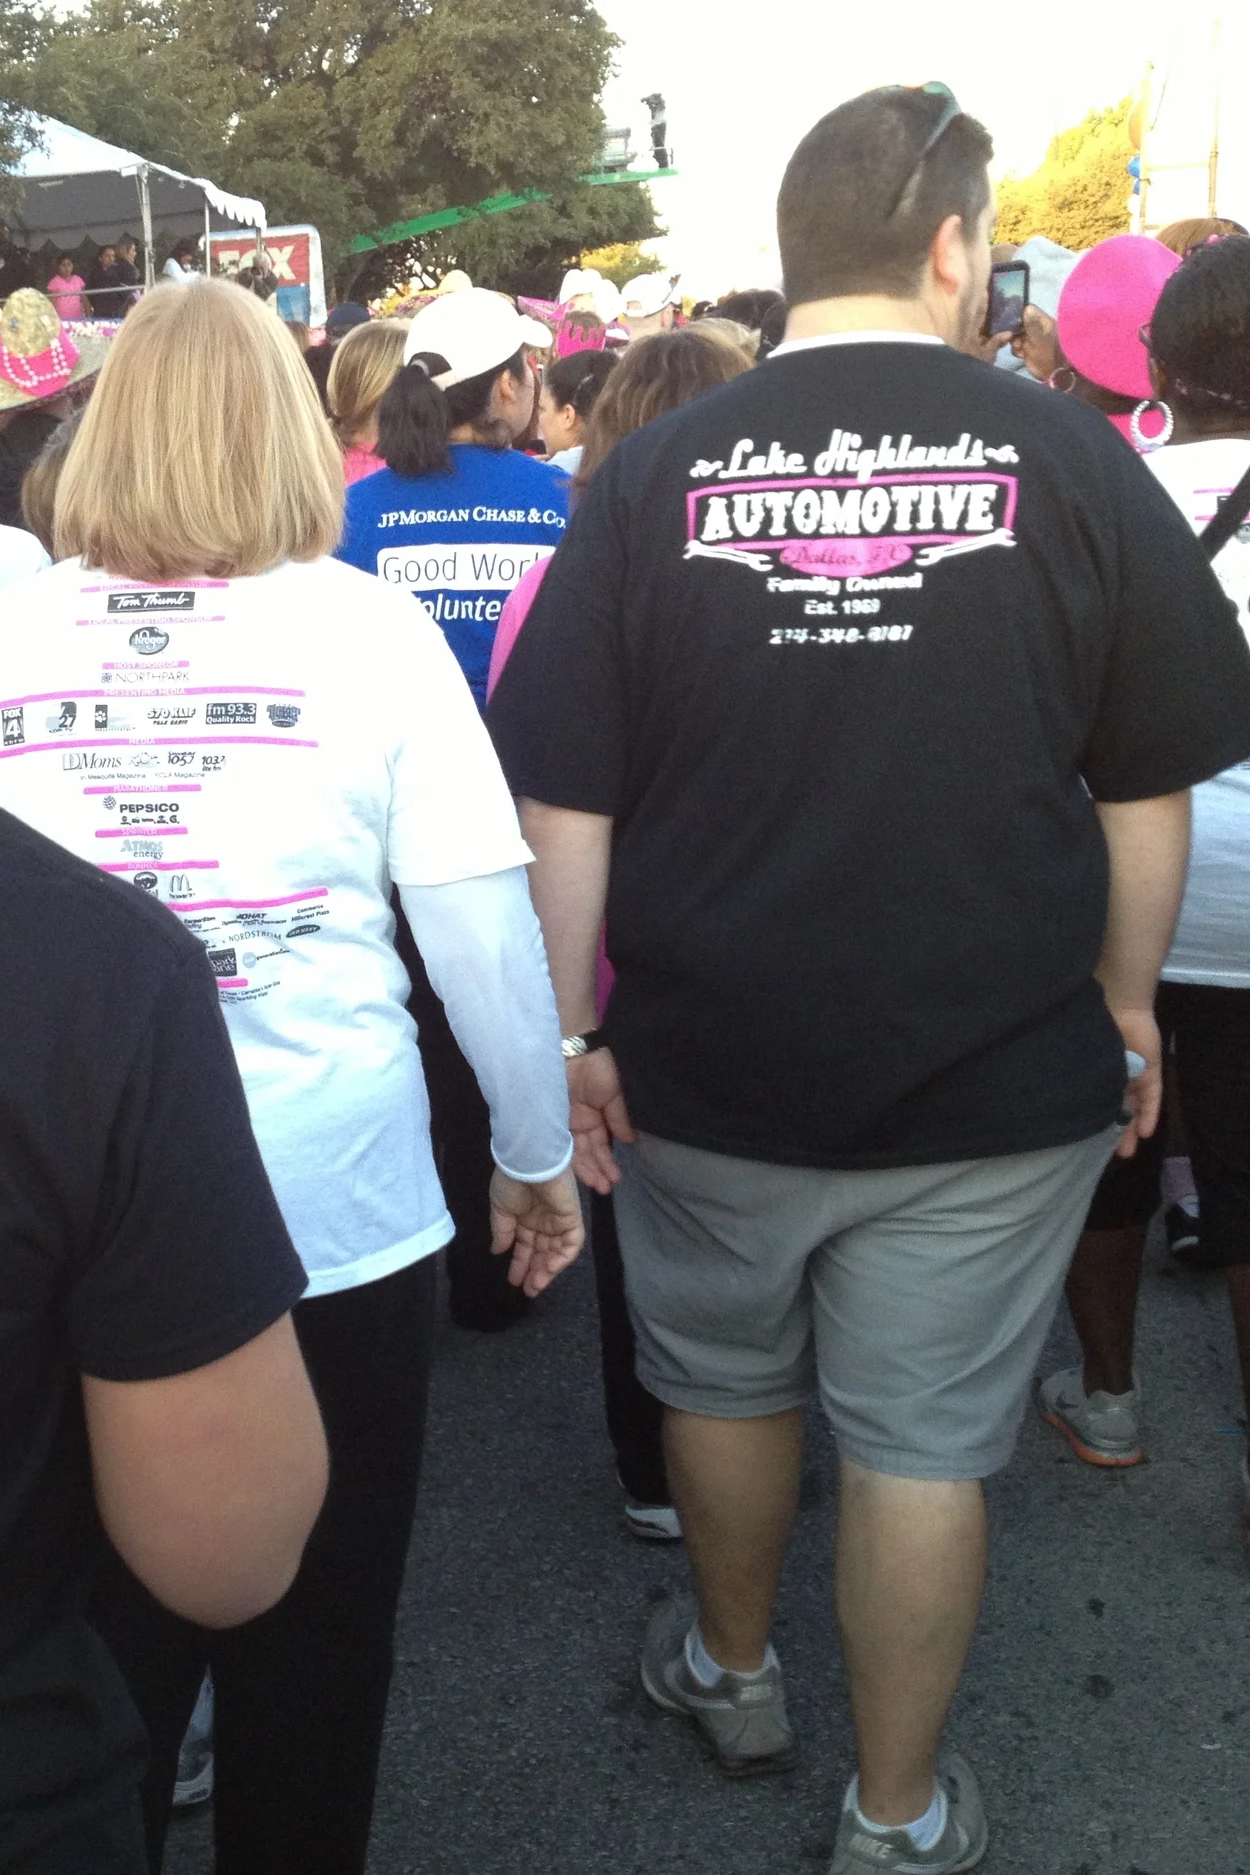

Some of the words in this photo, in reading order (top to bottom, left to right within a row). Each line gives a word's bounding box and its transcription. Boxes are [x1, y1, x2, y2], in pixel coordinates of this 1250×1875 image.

[218, 245, 297, 281] FOX
[718, 438, 807, 479] Lake
[814, 428, 987, 485] Highlands
[527, 507, 542, 524] &
[701, 484, 998, 541] AUTOMOTIVE
[383, 551, 457, 584] Good
[471, 552, 539, 581] Wor
[766, 575, 841, 596] Family
[845, 571, 924, 593] Owned
[112, 594, 141, 609] Tom
[141, 592, 190, 608] Thumb
[416, 593, 506, 622] olunte
[803, 599, 838, 615] Est.
[134, 629, 167, 652] Kroger
[115, 671, 191, 684] NORTHPARK
[2, 707, 22, 720] FOX
[206, 703, 226, 716] fm
[227, 702, 256, 716] 93.3
[6, 718, 21, 737] 4
[58, 714, 77, 729] 27
[206, 715, 235, 725] Quality
[235, 715, 256, 724] Rock
[119, 802, 180, 813] PEPSICO
[120, 839, 164, 852] ATMOS
[133, 850, 164, 861] energy
[228, 929, 282, 942] NORDSTROM
